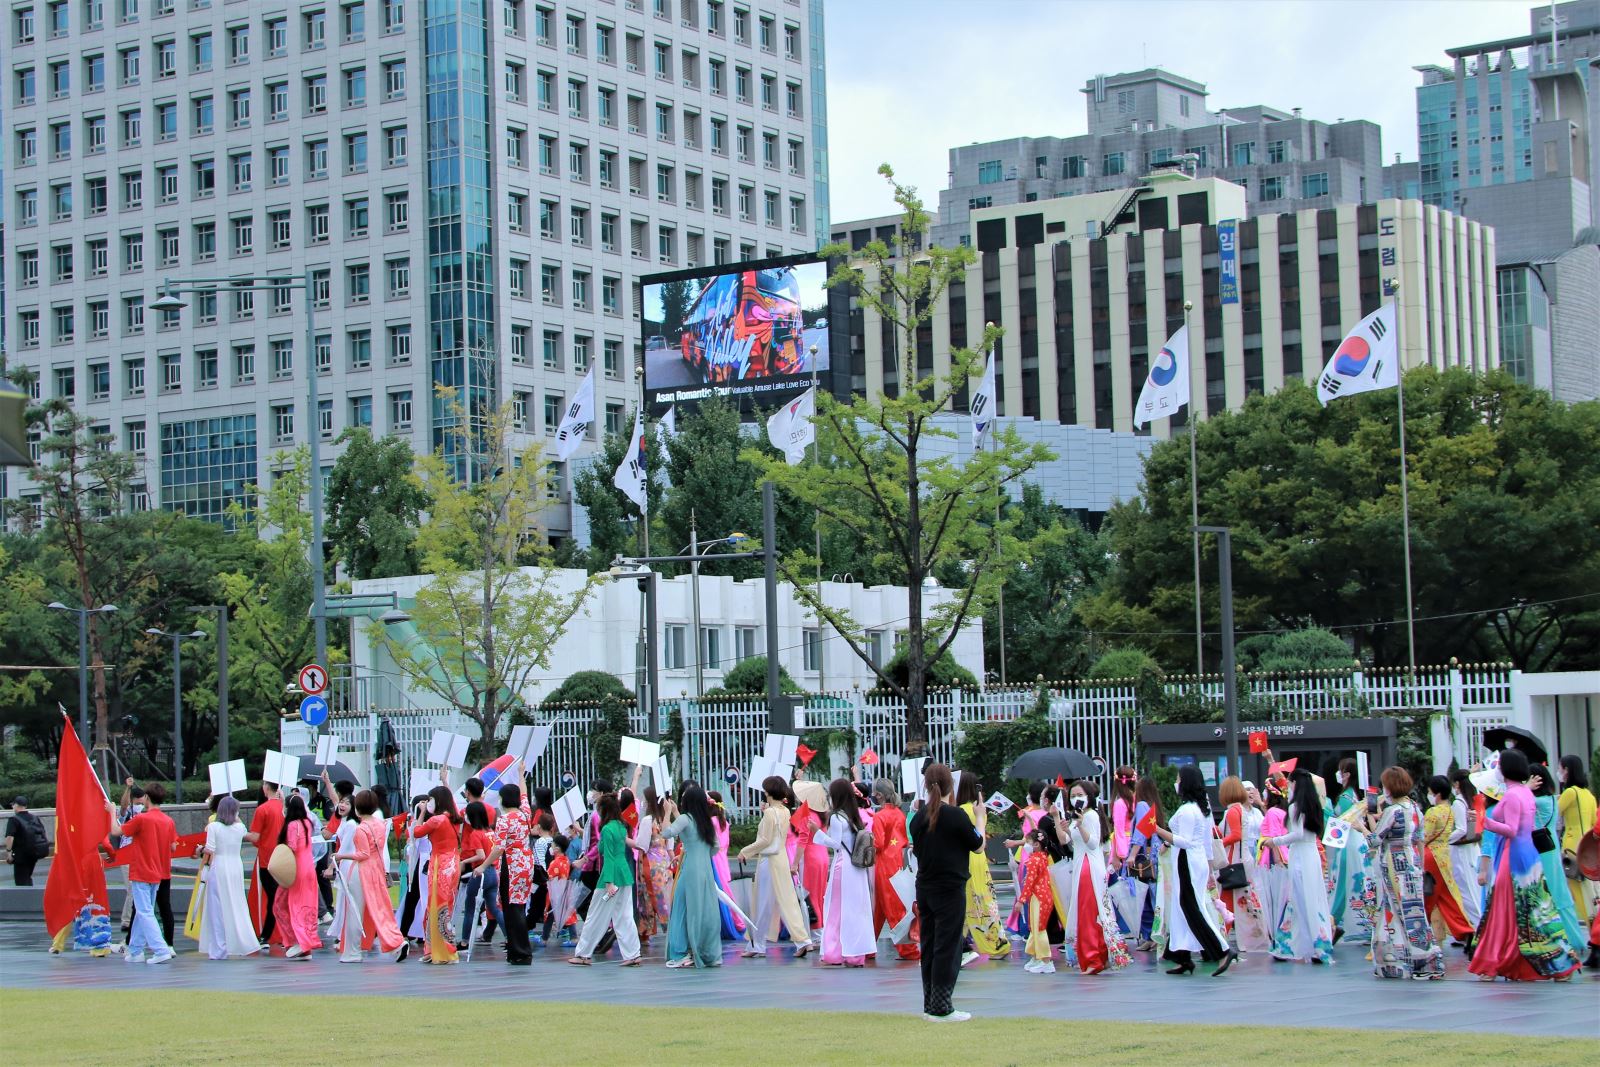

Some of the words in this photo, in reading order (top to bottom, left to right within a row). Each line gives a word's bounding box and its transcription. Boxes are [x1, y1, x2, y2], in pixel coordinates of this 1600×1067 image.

[704, 324, 757, 380] Valley
[656, 392, 676, 403] Asan
[676, 387, 712, 401] Romantic
[754, 384, 772, 392] Amuse
[772, 382, 785, 390] Lake
[799, 379, 810, 387] Eco
[1273, 725, 1305, 735] 알림마당
